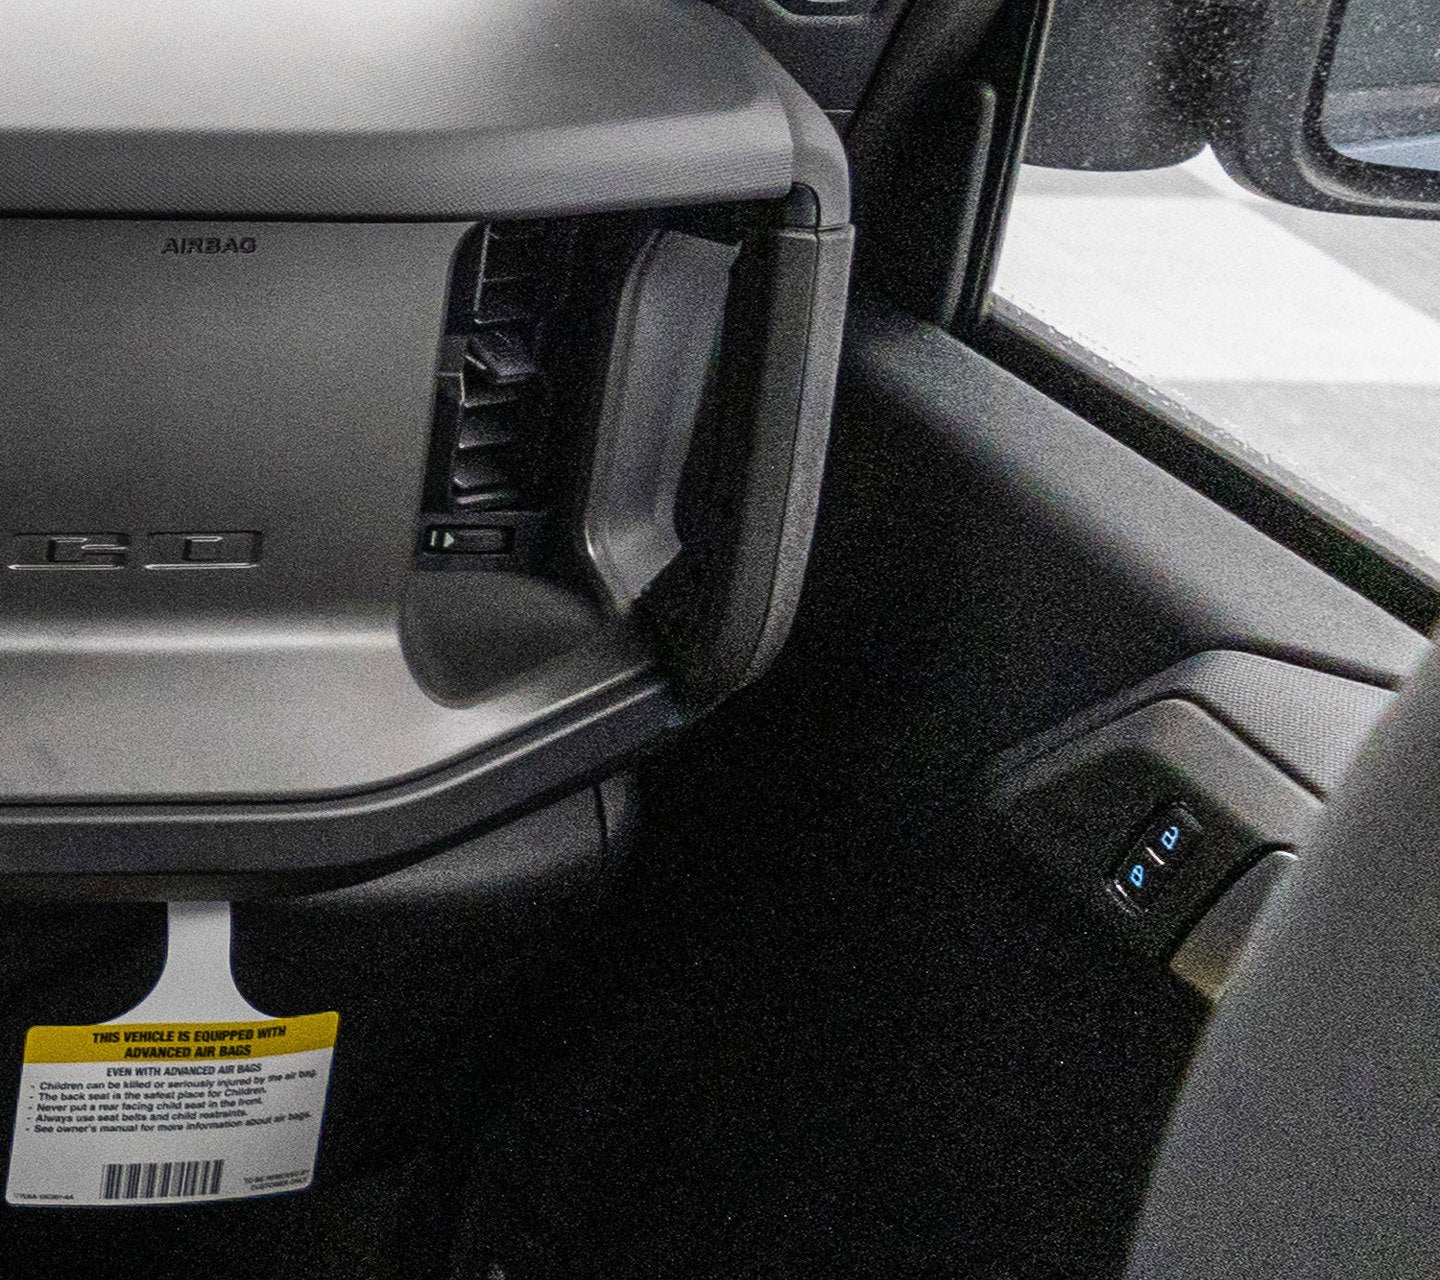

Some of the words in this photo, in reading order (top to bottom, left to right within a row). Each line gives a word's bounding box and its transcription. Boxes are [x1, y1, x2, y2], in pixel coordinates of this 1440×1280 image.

[161, 237, 258, 255] AIRBAG
[93, 1032, 120, 1043] THIS
[124, 1031, 175, 1042] VEHICLE
[178, 1031, 190, 1042] IS
[194, 1029, 254, 1042] EQUIPPED
[257, 1026, 287, 1039] WITH
[124, 1047, 191, 1058] ADVANCED
[194, 1047, 215, 1057] AIR
[219, 1045, 251, 1056] BAGS
[107, 1068, 133, 1077] EVEN
[135, 1067, 161, 1076] WITH
[163, 1066, 215, 1076] ADVANCED
[217, 1064, 235, 1074] AIR
[237, 1063, 262, 1073] BAGS
